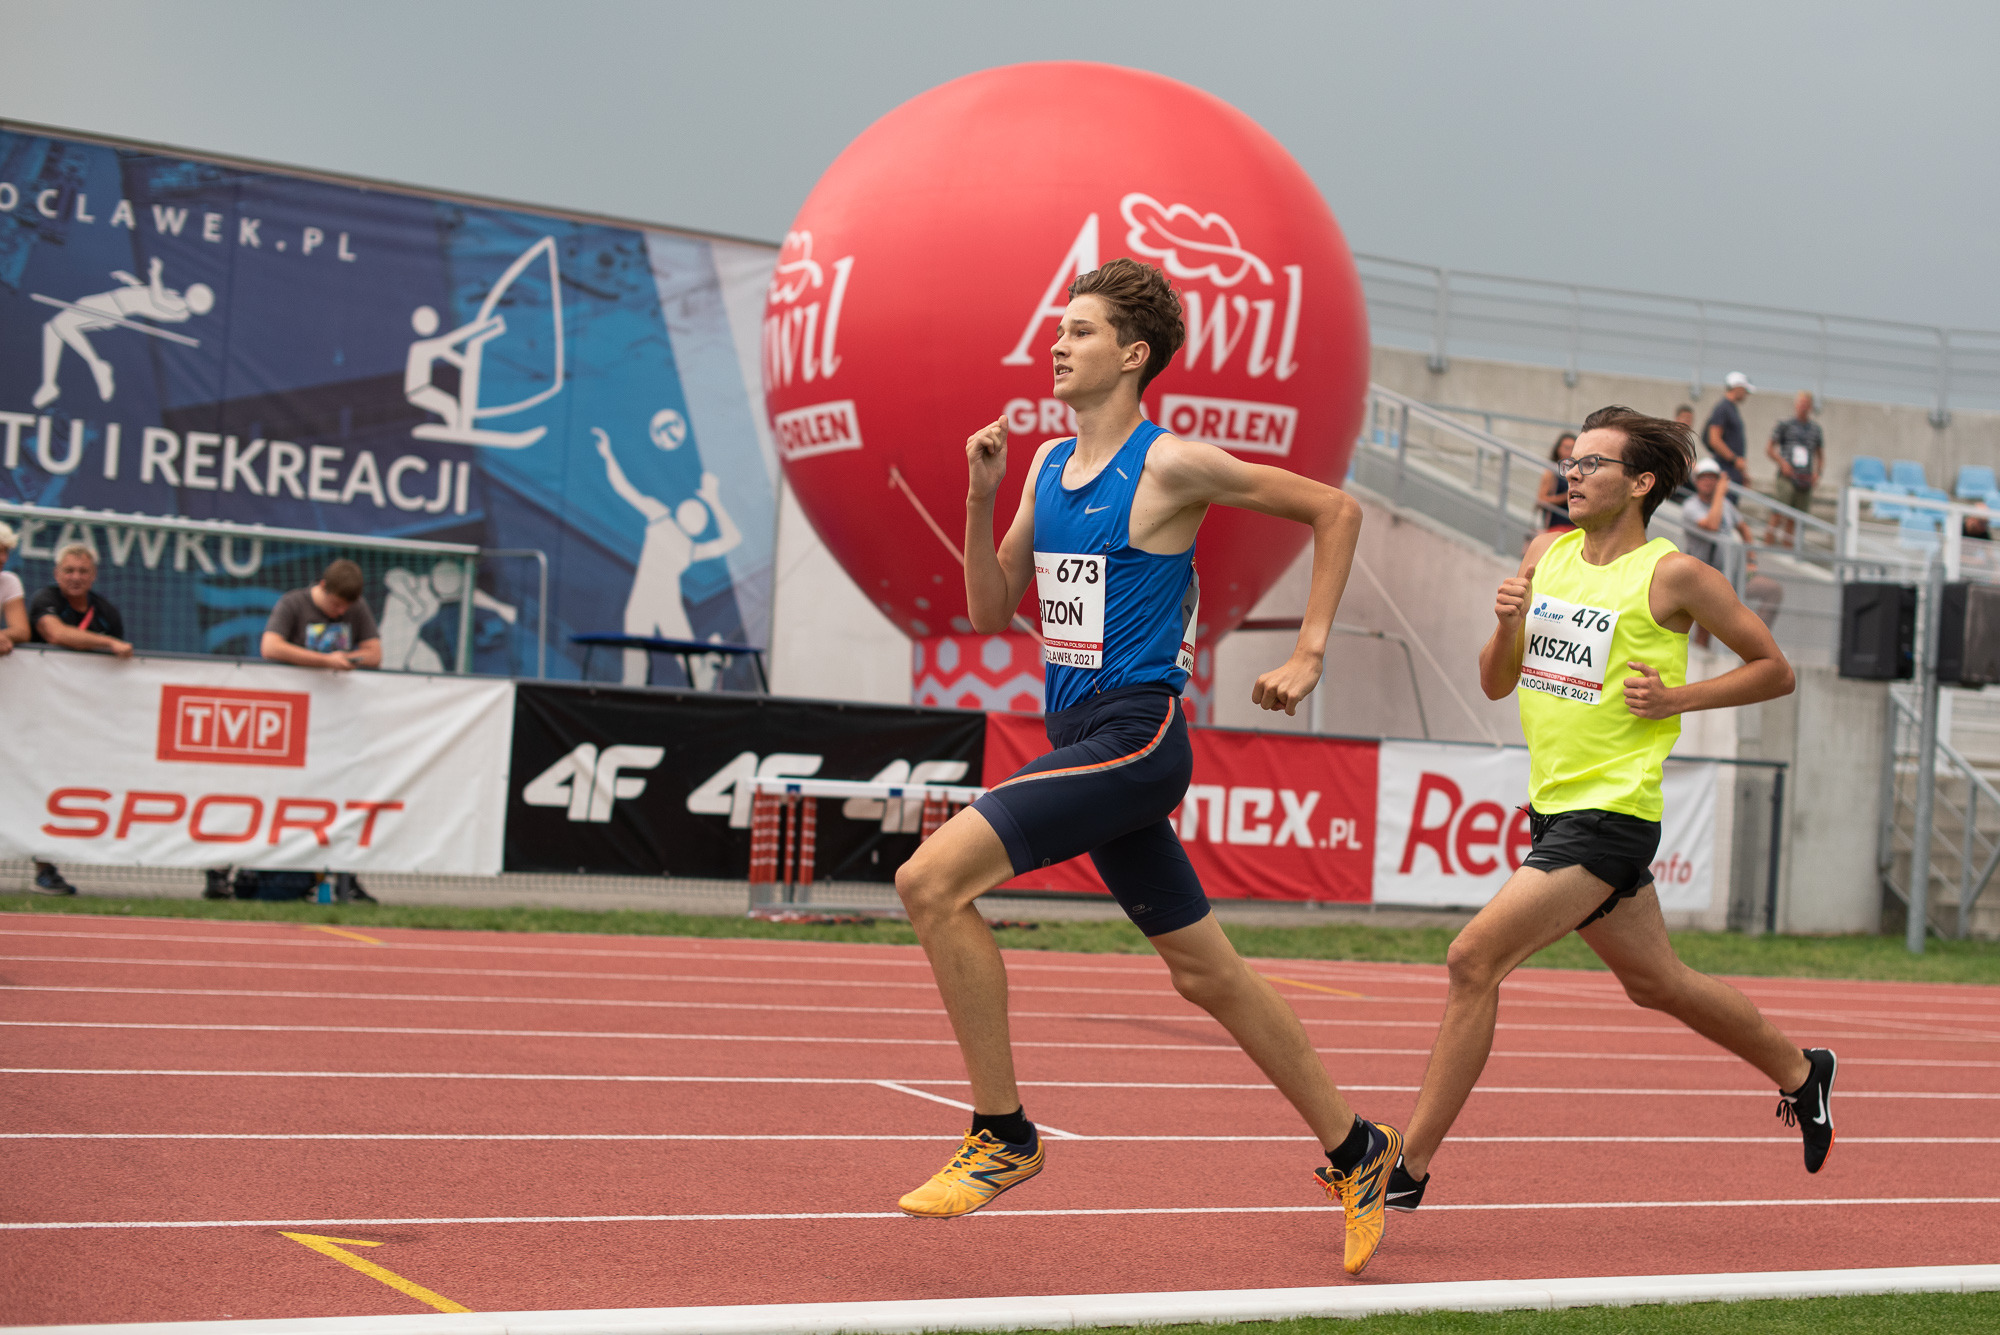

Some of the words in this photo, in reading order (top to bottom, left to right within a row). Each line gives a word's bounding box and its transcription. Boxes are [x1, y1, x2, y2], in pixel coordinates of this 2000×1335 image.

[1171, 404, 1289, 445] ORLEN
[0, 411, 84, 475] TU
[103, 422, 121, 480] I
[140, 427, 470, 516] REKREACJI
[1057, 559, 1099, 584] 673
[1540, 611, 1564, 620] OLIMP
[1572, 608, 1612, 632] 476
[1074, 653, 1095, 665] 2021
[1528, 634, 1592, 668] KISZKA
[1571, 688, 1594, 702] 2021
[185, 706, 281, 746] TVP
[523, 742, 665, 823] 4F
[41, 787, 404, 847] SPORT
